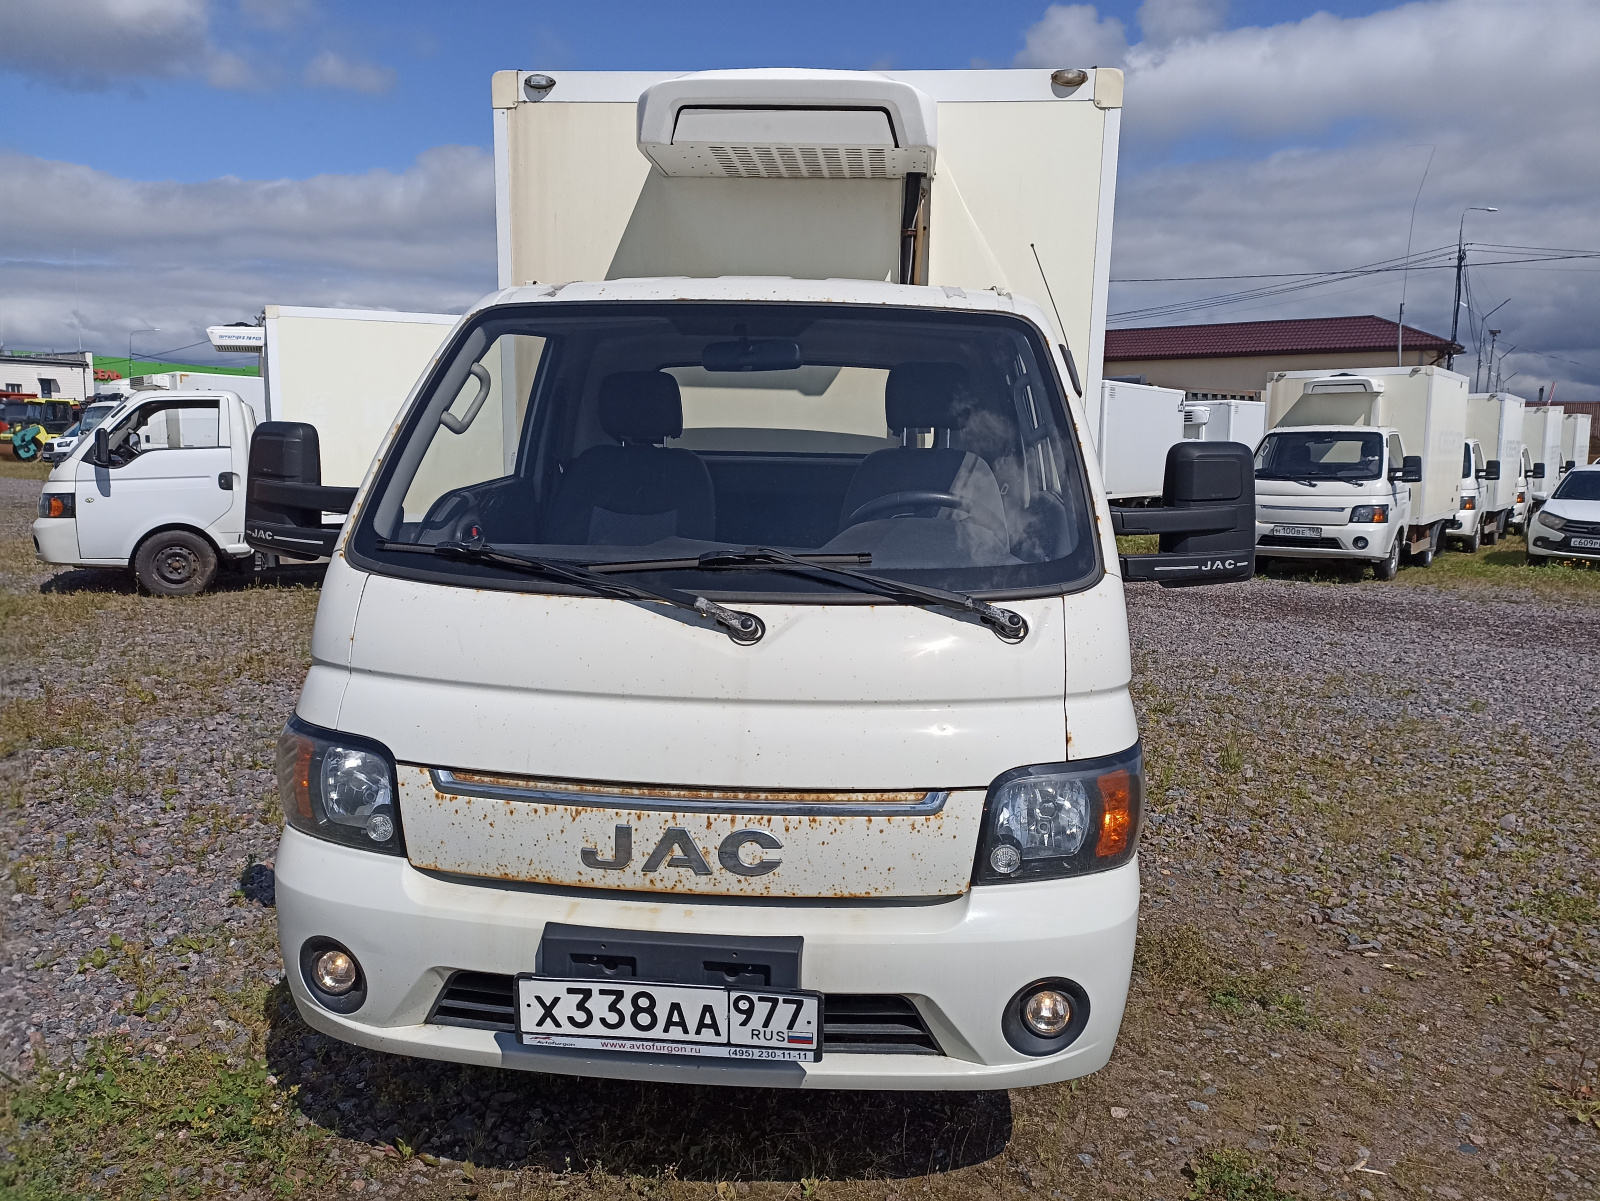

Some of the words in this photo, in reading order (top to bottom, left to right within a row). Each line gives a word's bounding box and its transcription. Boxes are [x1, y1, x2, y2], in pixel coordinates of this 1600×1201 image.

[252, 528, 273, 540] JAC
[1573, 539, 1600, 547] С609Р
[1201, 559, 1235, 570] JAC
[580, 823, 784, 877] JAC
[732, 994, 805, 1031] 977
[751, 1028, 786, 1042] RUS
[600, 1040, 701, 1055] www.avtofurgon.ru
[728, 1048, 755, 1058] (495)
[757, 1050, 808, 1060] 230-11-11
